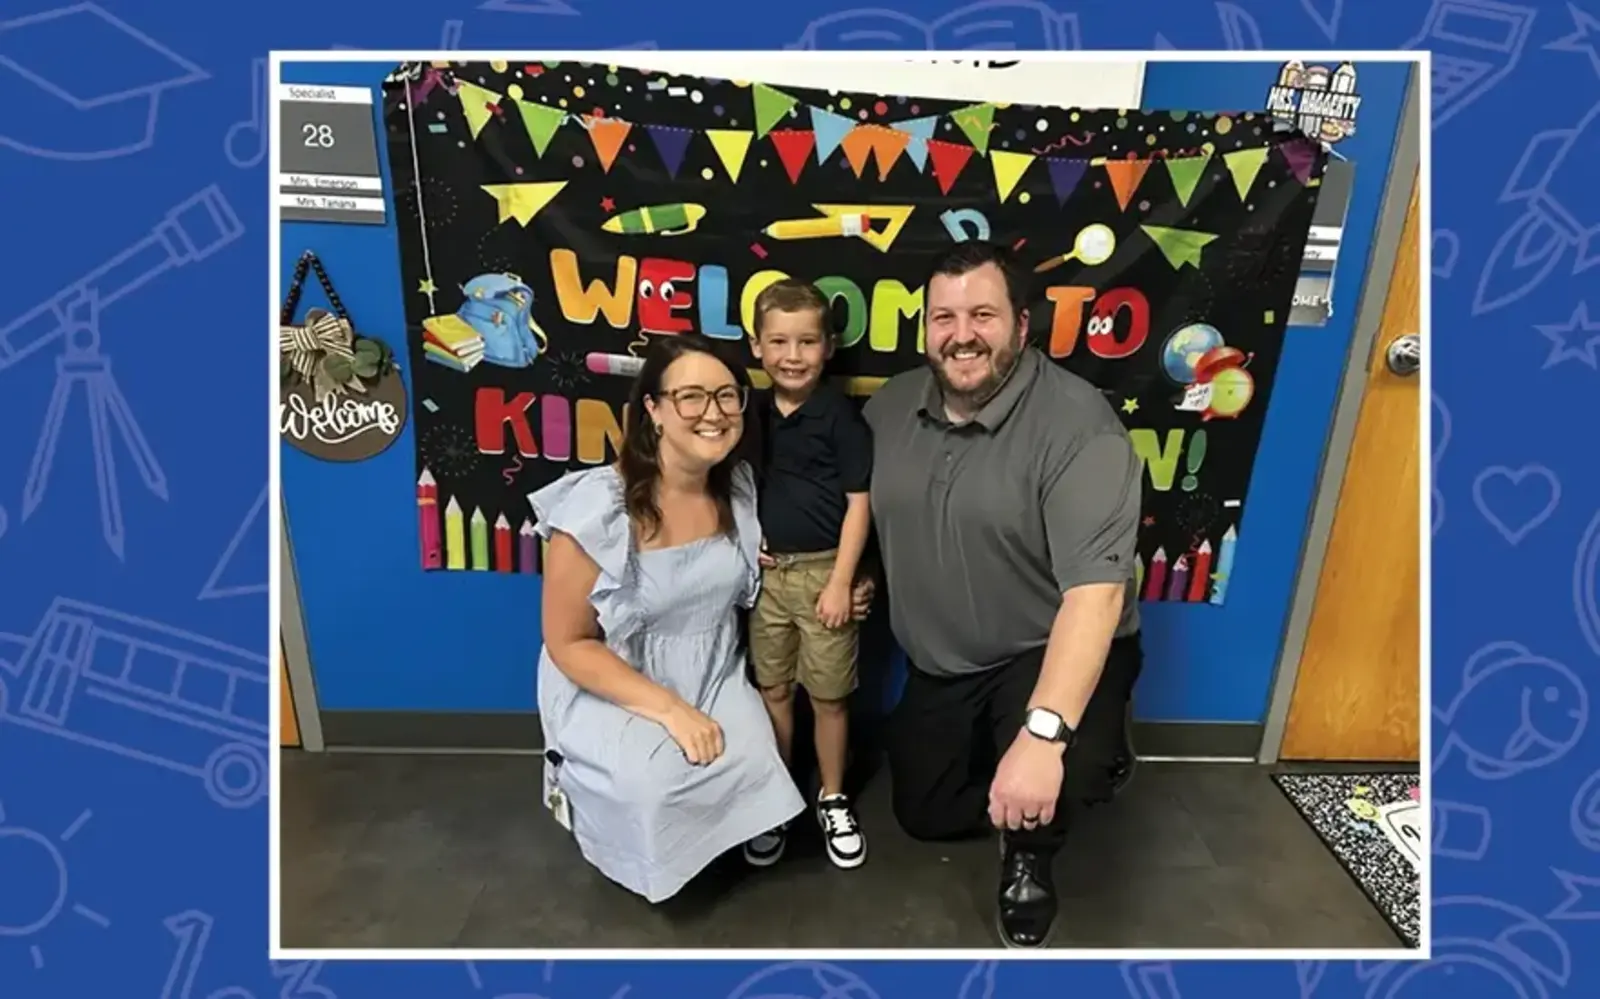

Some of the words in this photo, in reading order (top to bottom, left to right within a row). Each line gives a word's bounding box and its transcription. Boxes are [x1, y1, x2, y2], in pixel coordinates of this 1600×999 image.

[288, 87, 336, 100] Specialist
[302, 123, 335, 148] 28
[290, 176, 309, 187] Mrs.
[1045, 285, 1150, 359] TO
